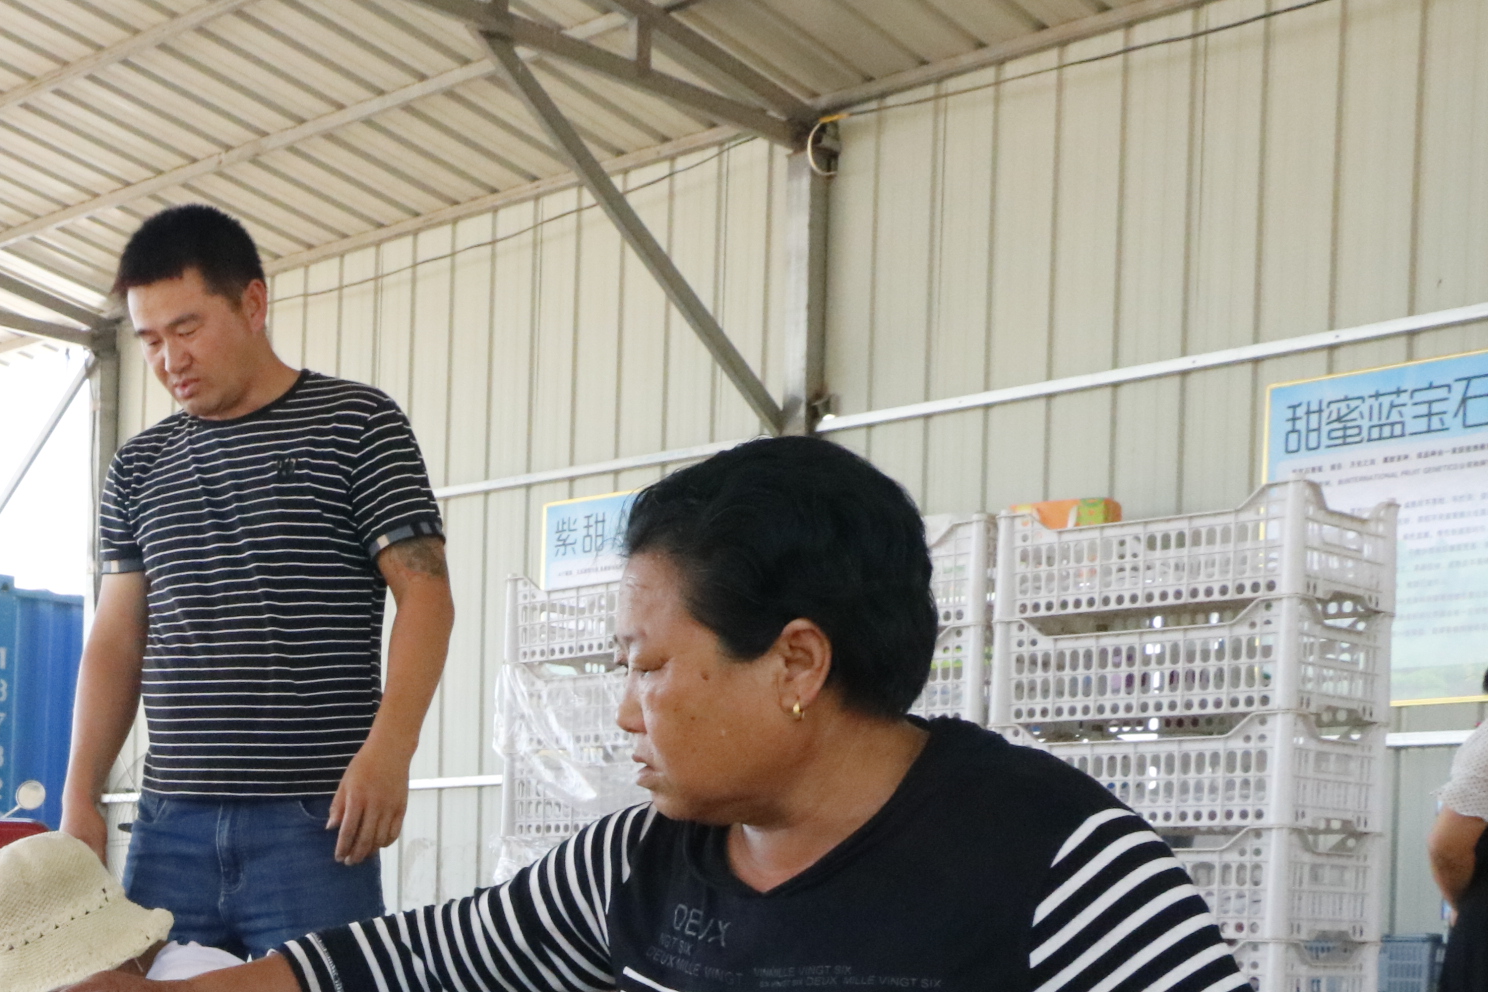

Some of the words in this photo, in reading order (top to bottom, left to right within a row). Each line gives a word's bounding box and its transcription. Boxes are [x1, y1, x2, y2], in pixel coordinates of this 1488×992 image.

[1284, 374, 1488, 454] 甜蜜蓝宝石
[878, 976, 917, 988] VINGT
[920, 978, 942, 989] SIX
